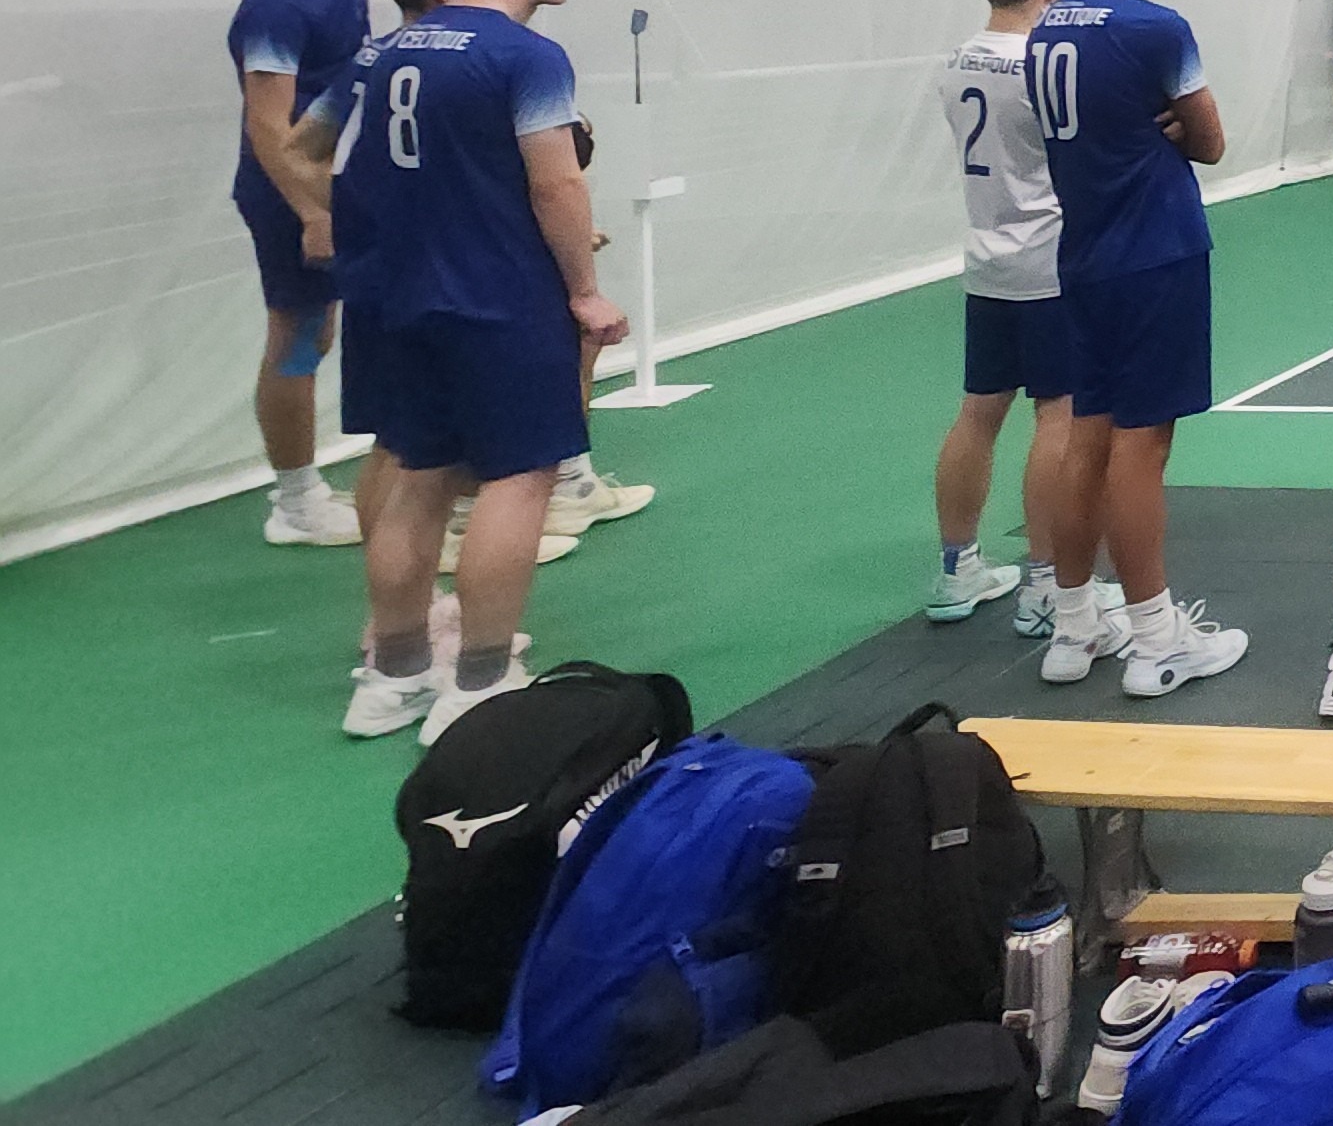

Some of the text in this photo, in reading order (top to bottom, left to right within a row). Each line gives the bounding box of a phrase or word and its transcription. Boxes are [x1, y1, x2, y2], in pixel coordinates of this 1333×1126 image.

[389, 65, 421, 169] 8
[961, 87, 990, 177] 2
[1032, 42, 1078, 140] 10
